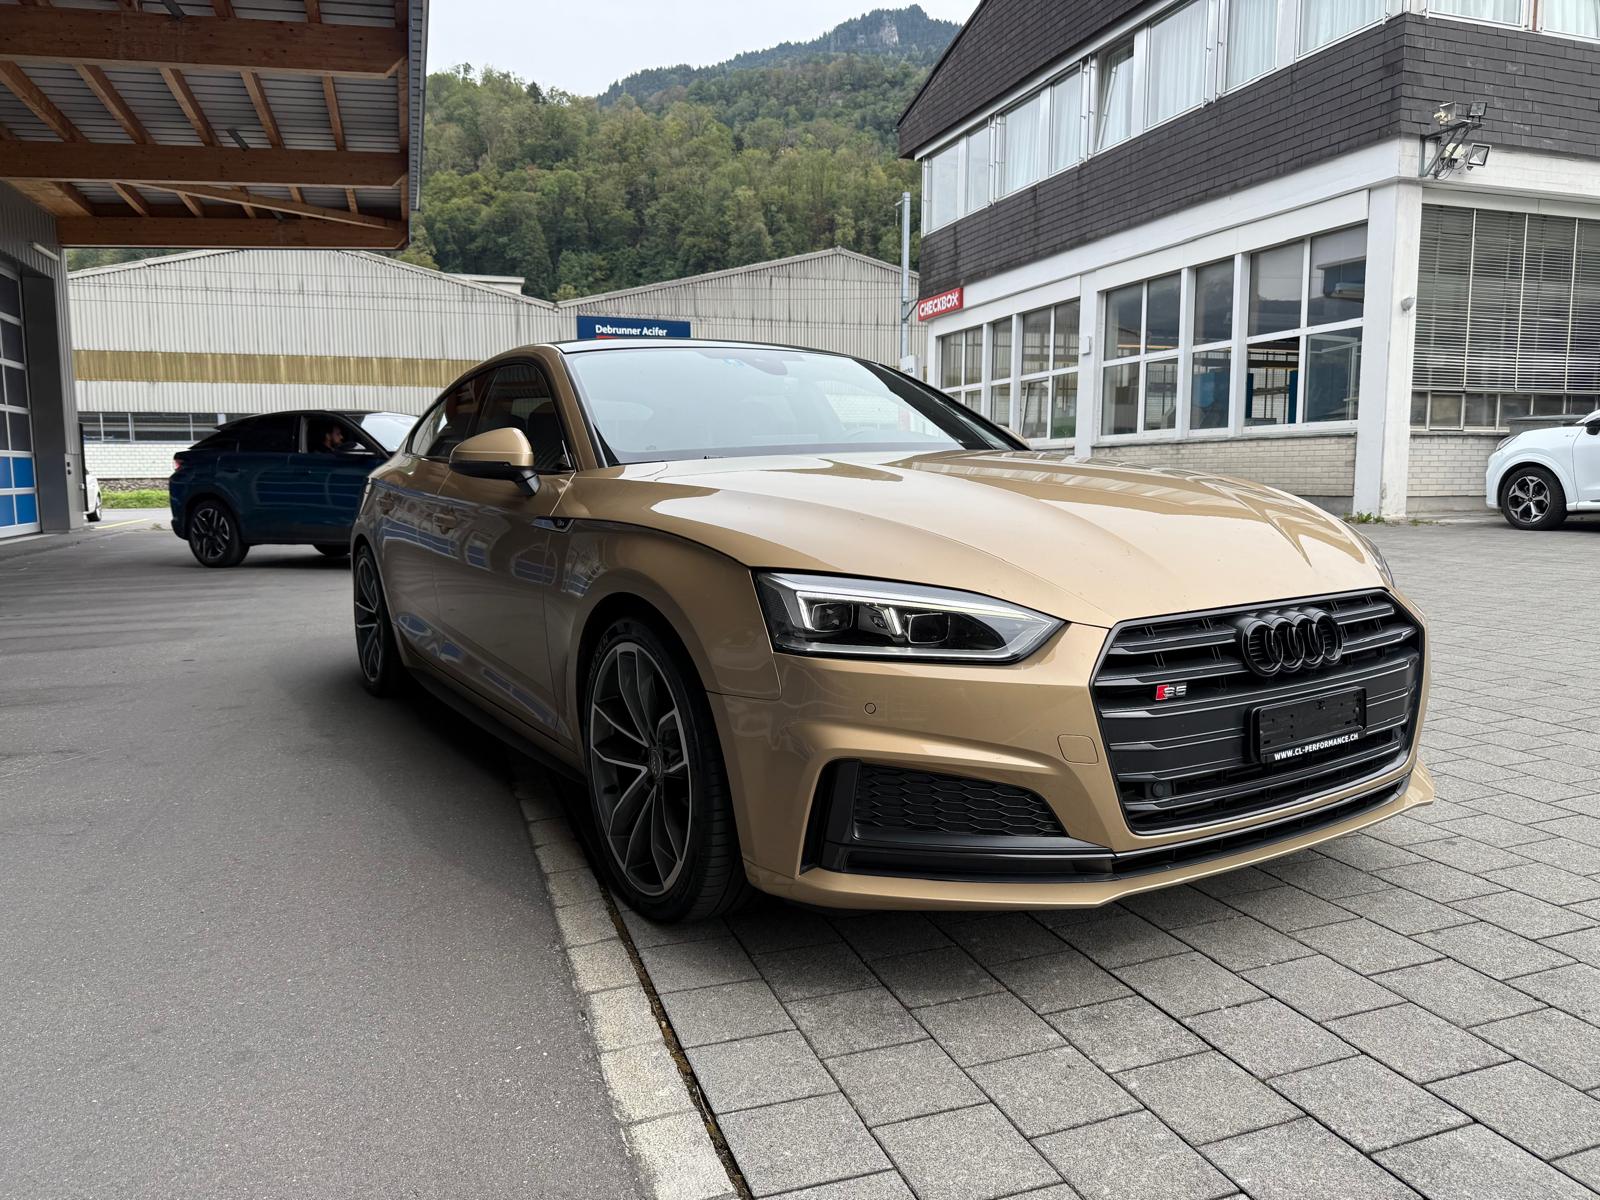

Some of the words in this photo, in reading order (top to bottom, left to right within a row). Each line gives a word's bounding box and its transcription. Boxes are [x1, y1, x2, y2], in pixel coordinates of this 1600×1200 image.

[919, 291, 959, 317] CHECKBOX
[595, 324, 641, 336] Debrunner
[642, 326, 668, 337] Acifer
[1163, 684, 1187, 698] S5
[1274, 732, 1359, 761] WWW.CL-PERFORMANCE.CH
